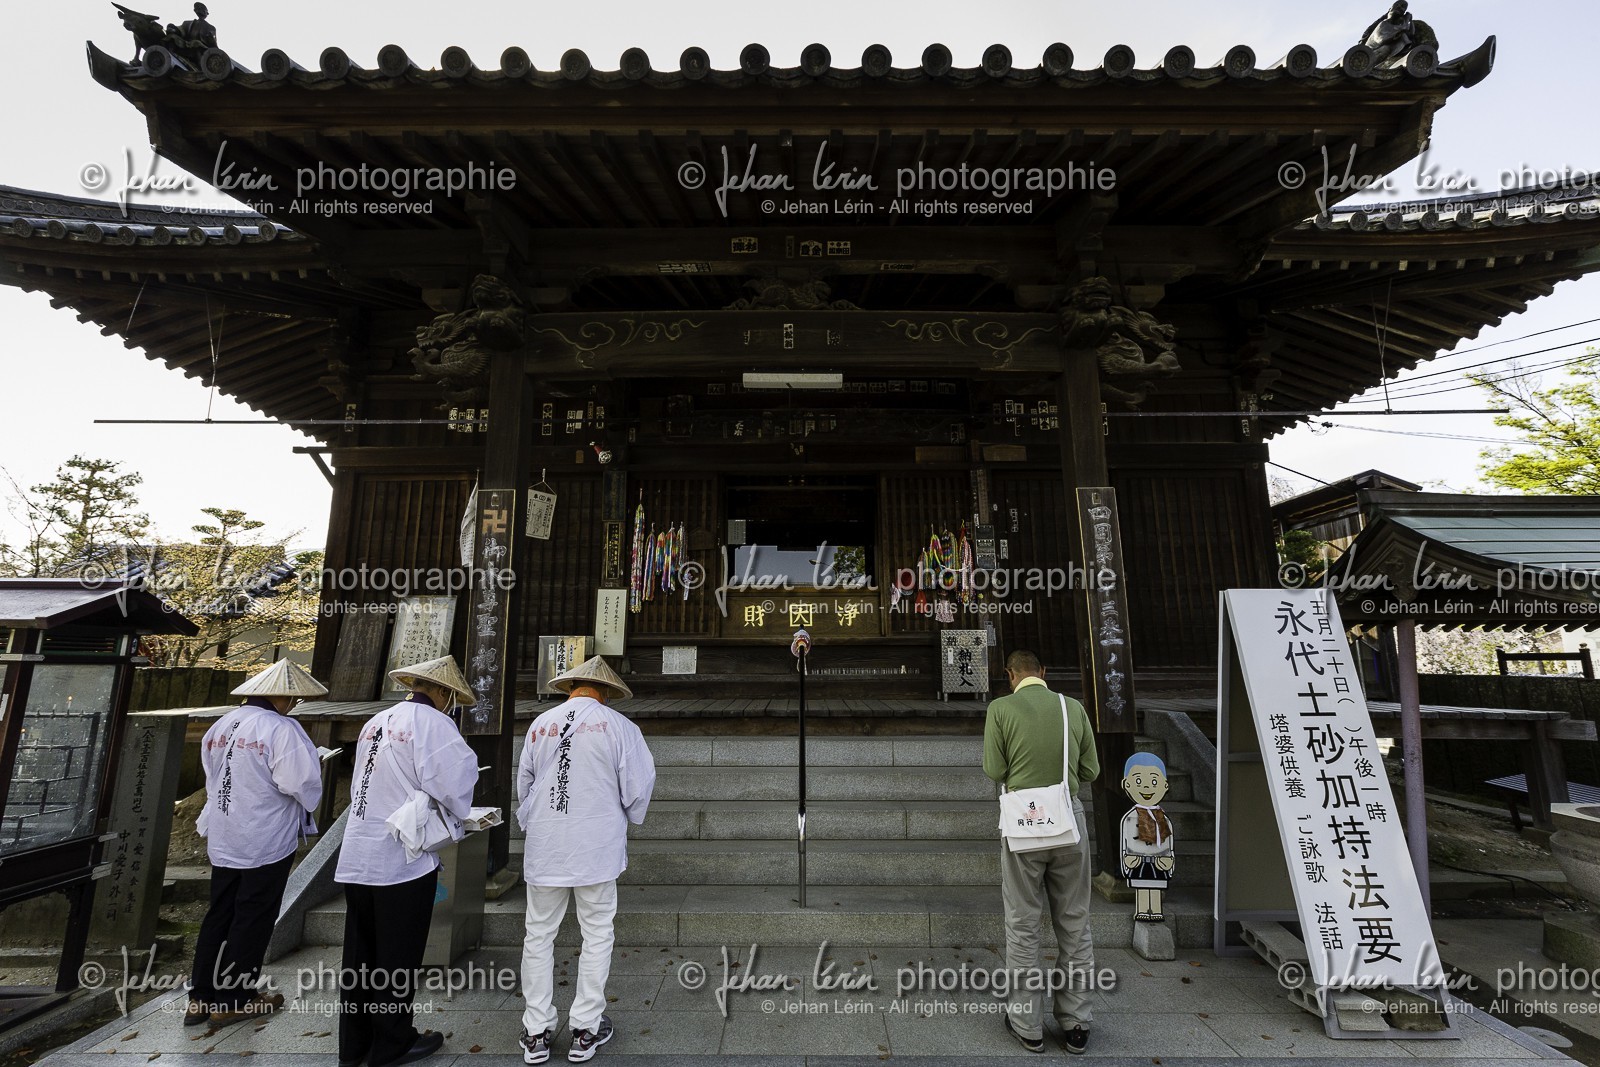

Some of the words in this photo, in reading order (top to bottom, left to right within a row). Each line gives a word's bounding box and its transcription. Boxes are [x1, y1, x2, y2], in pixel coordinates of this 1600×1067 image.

[956, 648, 974, 687] 納札入
[1017, 817, 1054, 826] 同行二人
[1269, 713, 1306, 799] 塔婆供養
[1297, 814, 1328, 884] ご詠歌
[1314, 901, 1344, 951] 法話
[1274, 600, 1403, 964] 永代土砂加持法要
